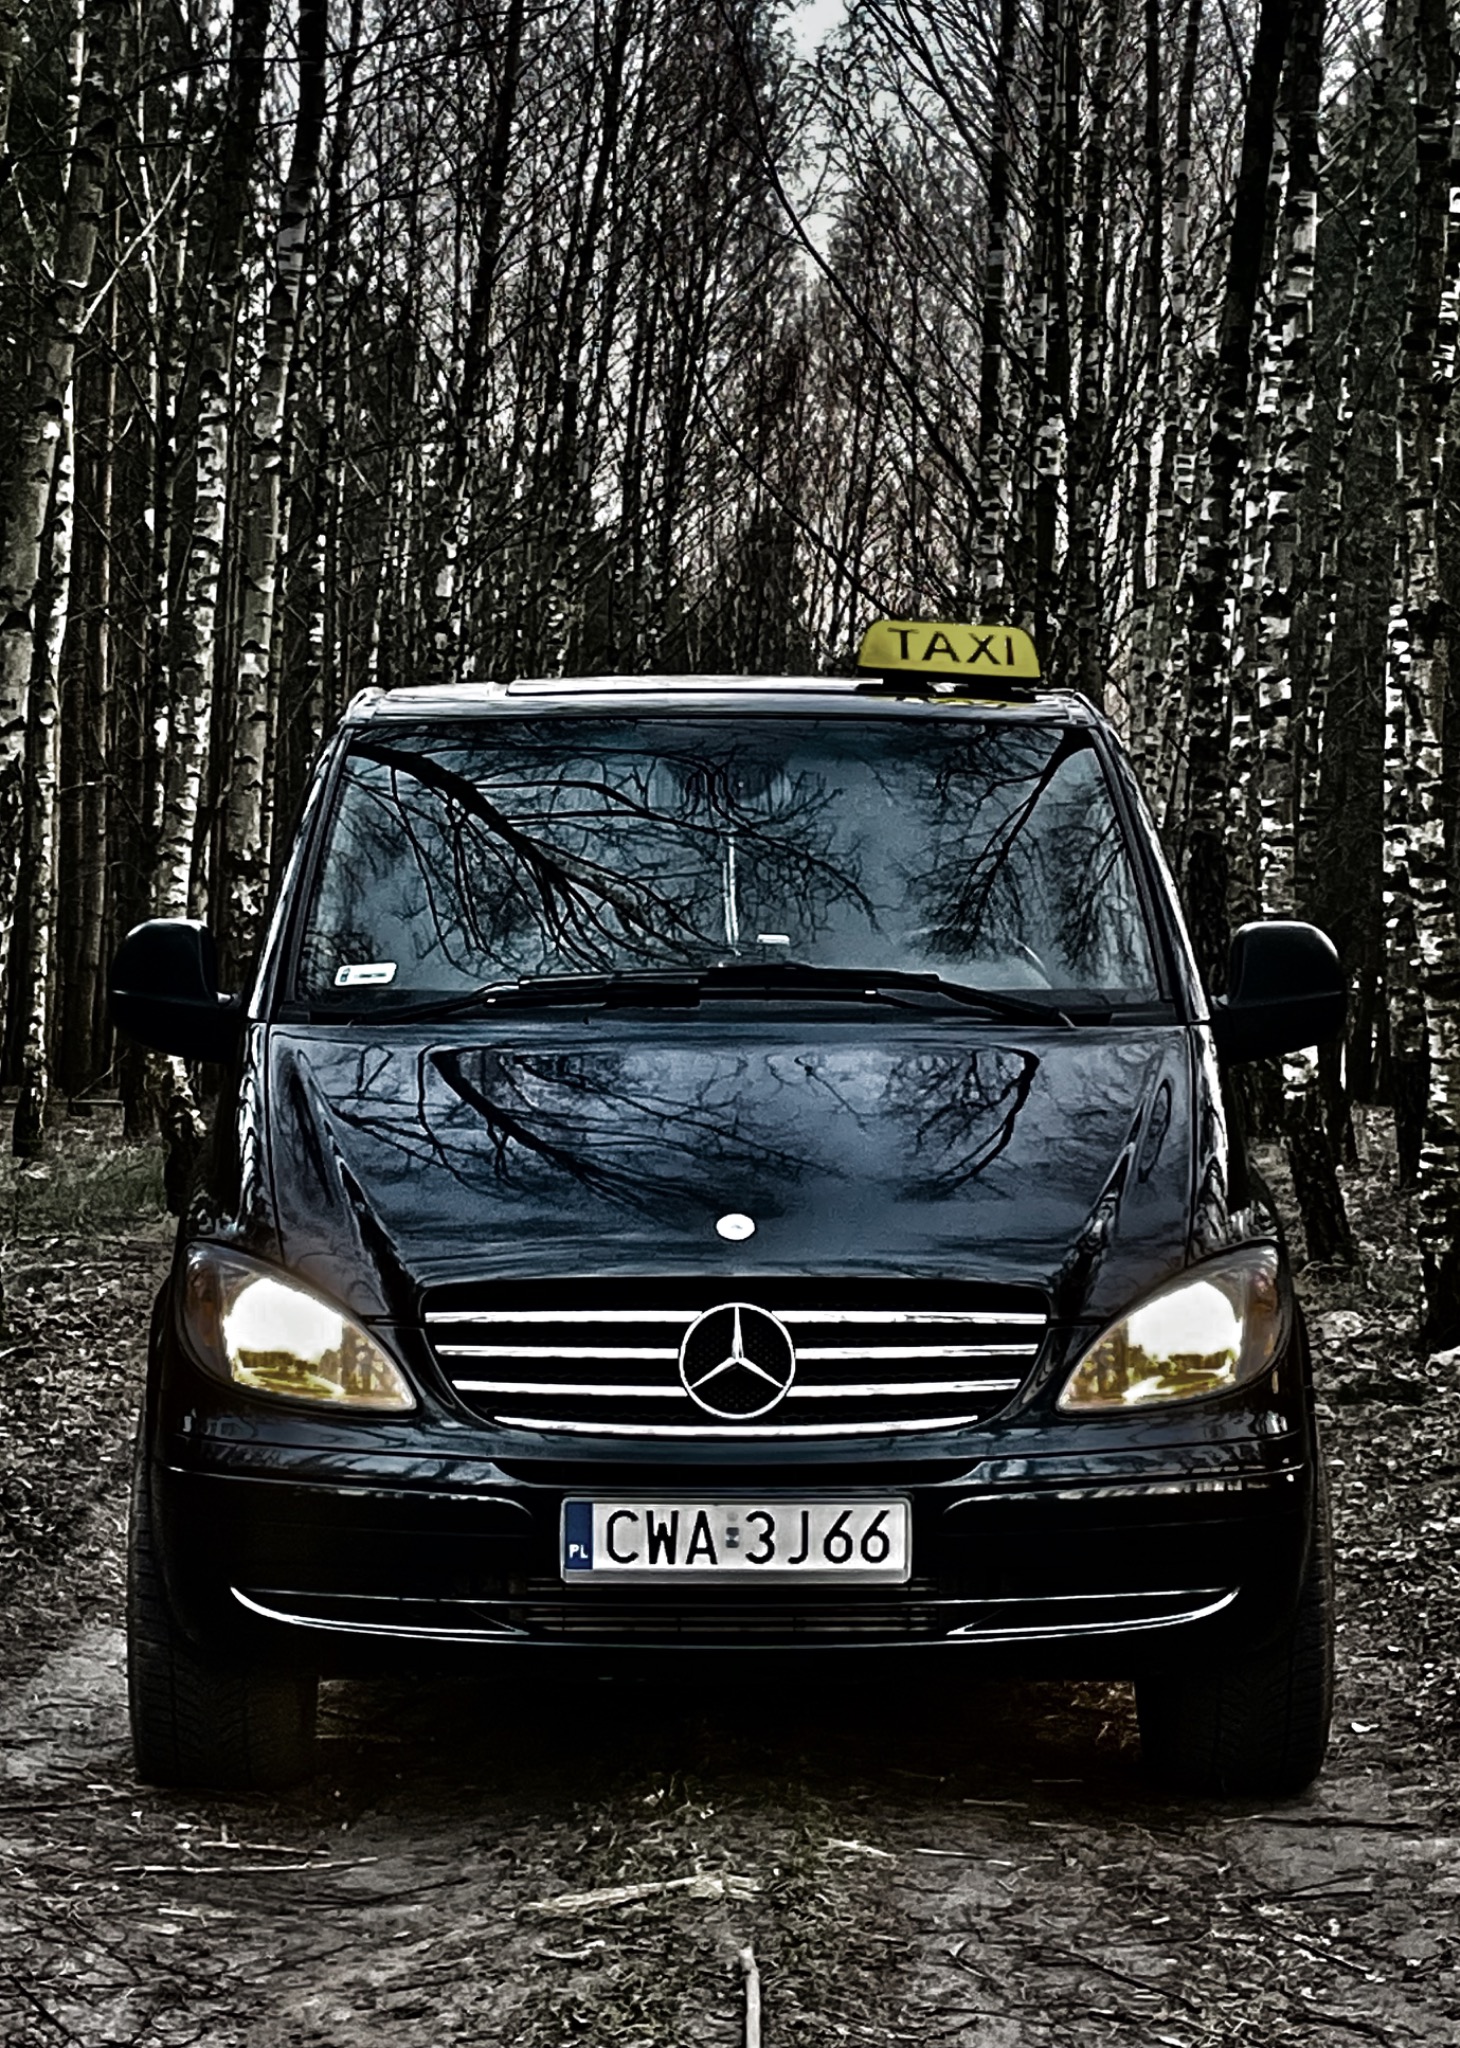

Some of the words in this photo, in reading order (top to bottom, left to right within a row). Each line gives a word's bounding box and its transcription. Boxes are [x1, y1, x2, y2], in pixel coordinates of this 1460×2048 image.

[887, 627, 1015, 666] TAXI
[569, 1544, 588, 1559] PL
[606, 1509, 719, 1565] CWA
[745, 1509, 891, 1565] 3J66
